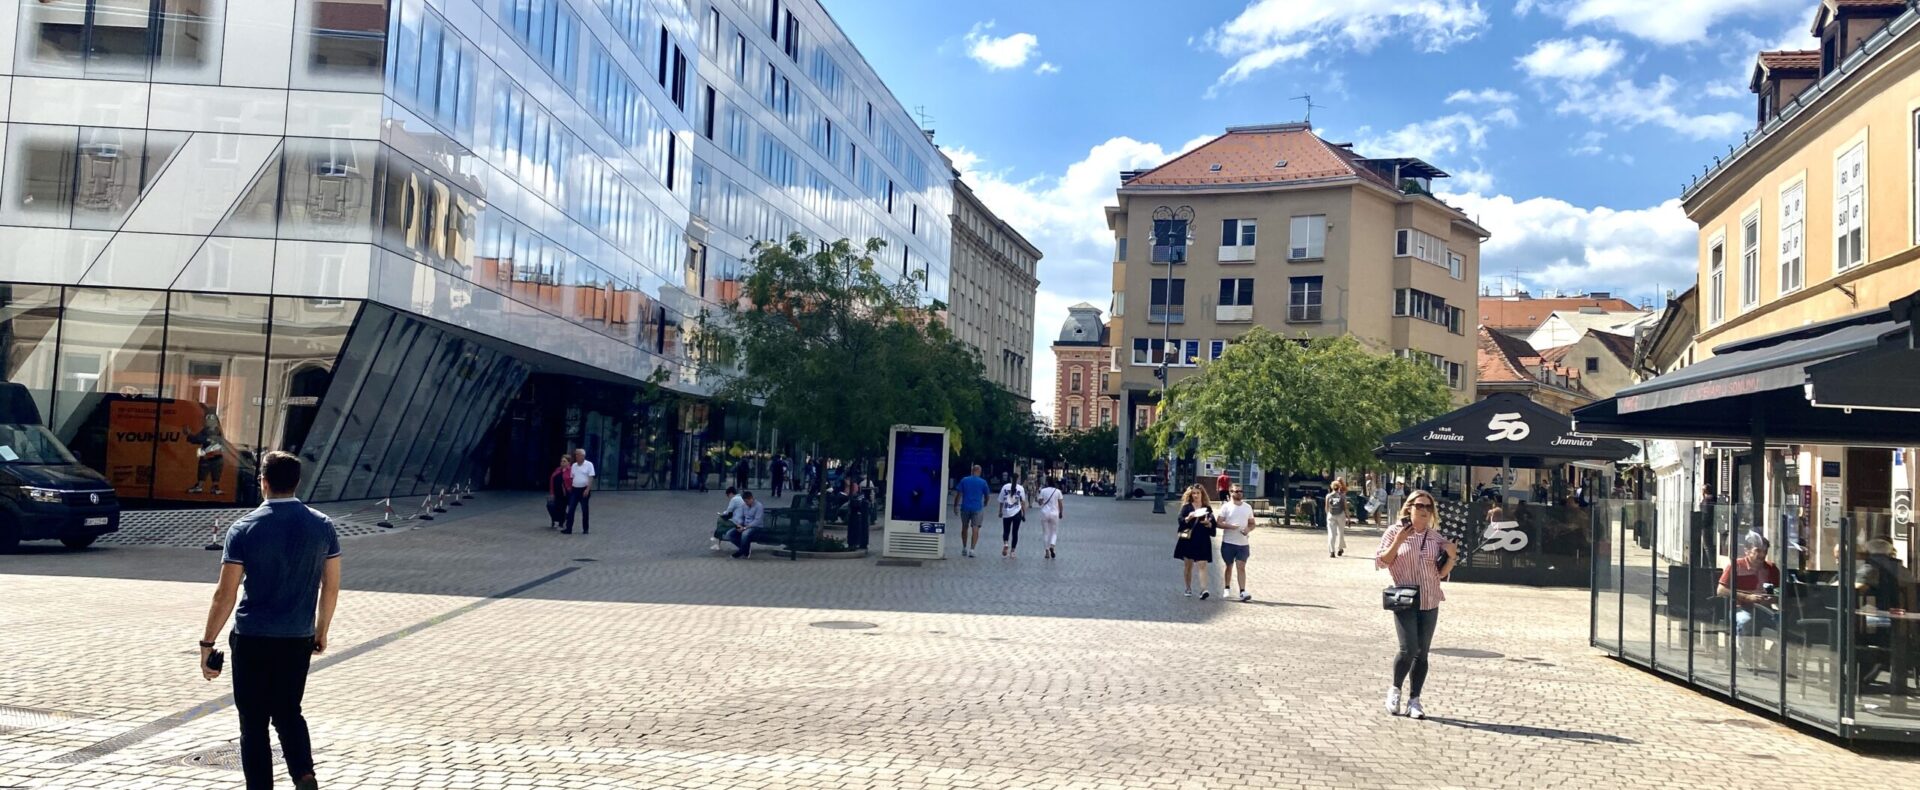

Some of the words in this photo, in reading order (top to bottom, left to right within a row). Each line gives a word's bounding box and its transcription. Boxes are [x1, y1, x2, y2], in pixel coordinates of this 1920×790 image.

[1422, 430, 1465, 442] Jamnica
[1485, 412, 1530, 441] 50
[1550, 435, 1593, 447] Jamnica
[1480, 521, 1529, 552] 50
